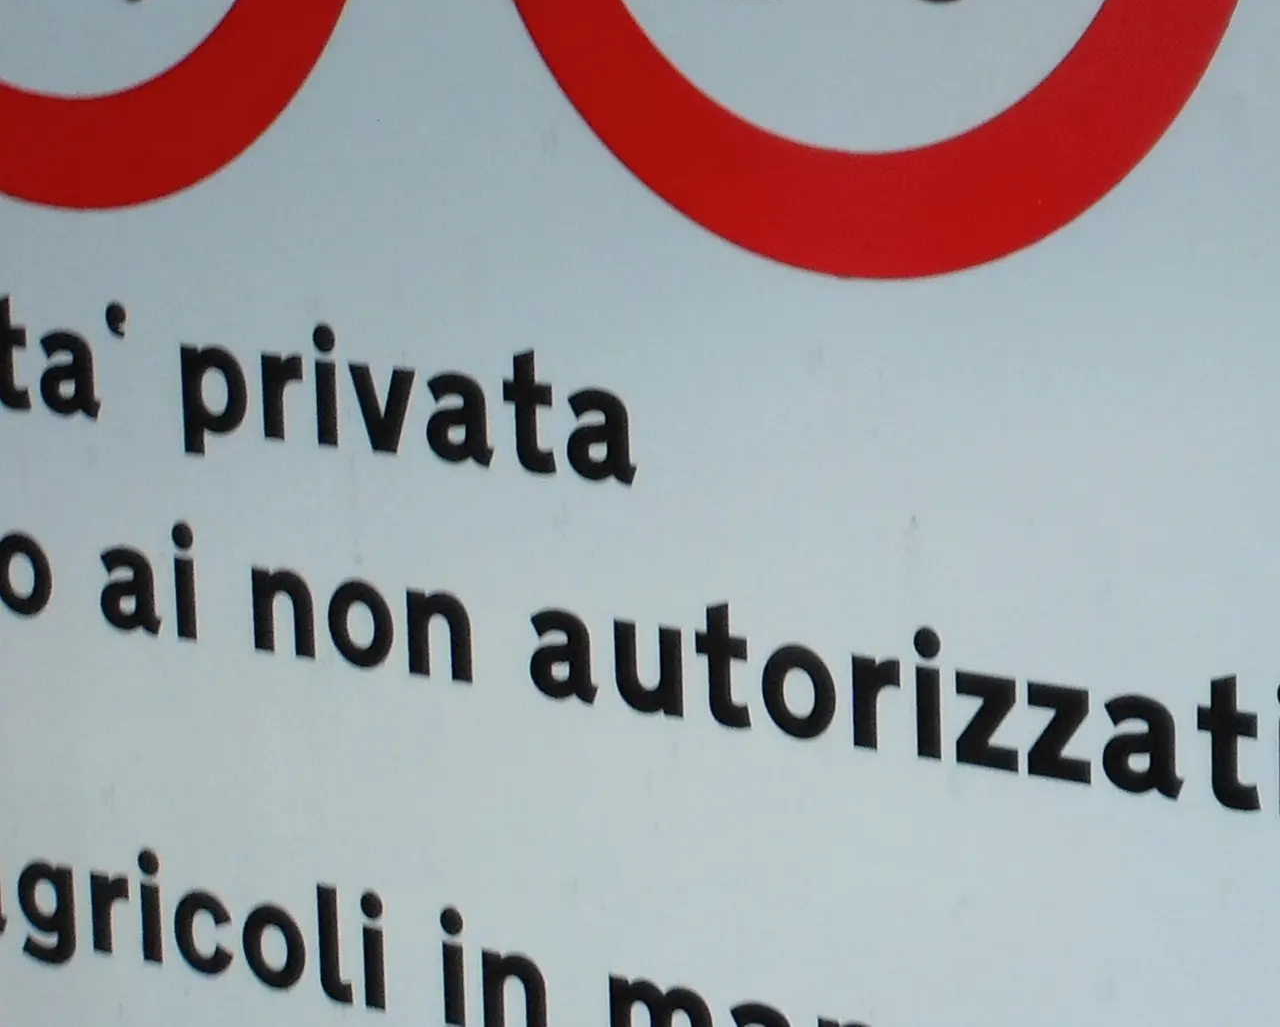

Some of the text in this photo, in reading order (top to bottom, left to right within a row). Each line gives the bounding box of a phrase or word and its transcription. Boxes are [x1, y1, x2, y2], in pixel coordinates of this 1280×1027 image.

[179, 322, 638, 487] privata
[99, 521, 199, 641] ai
[250, 566, 474, 684] non
[0, 848, 548, 1027] gricoli in
